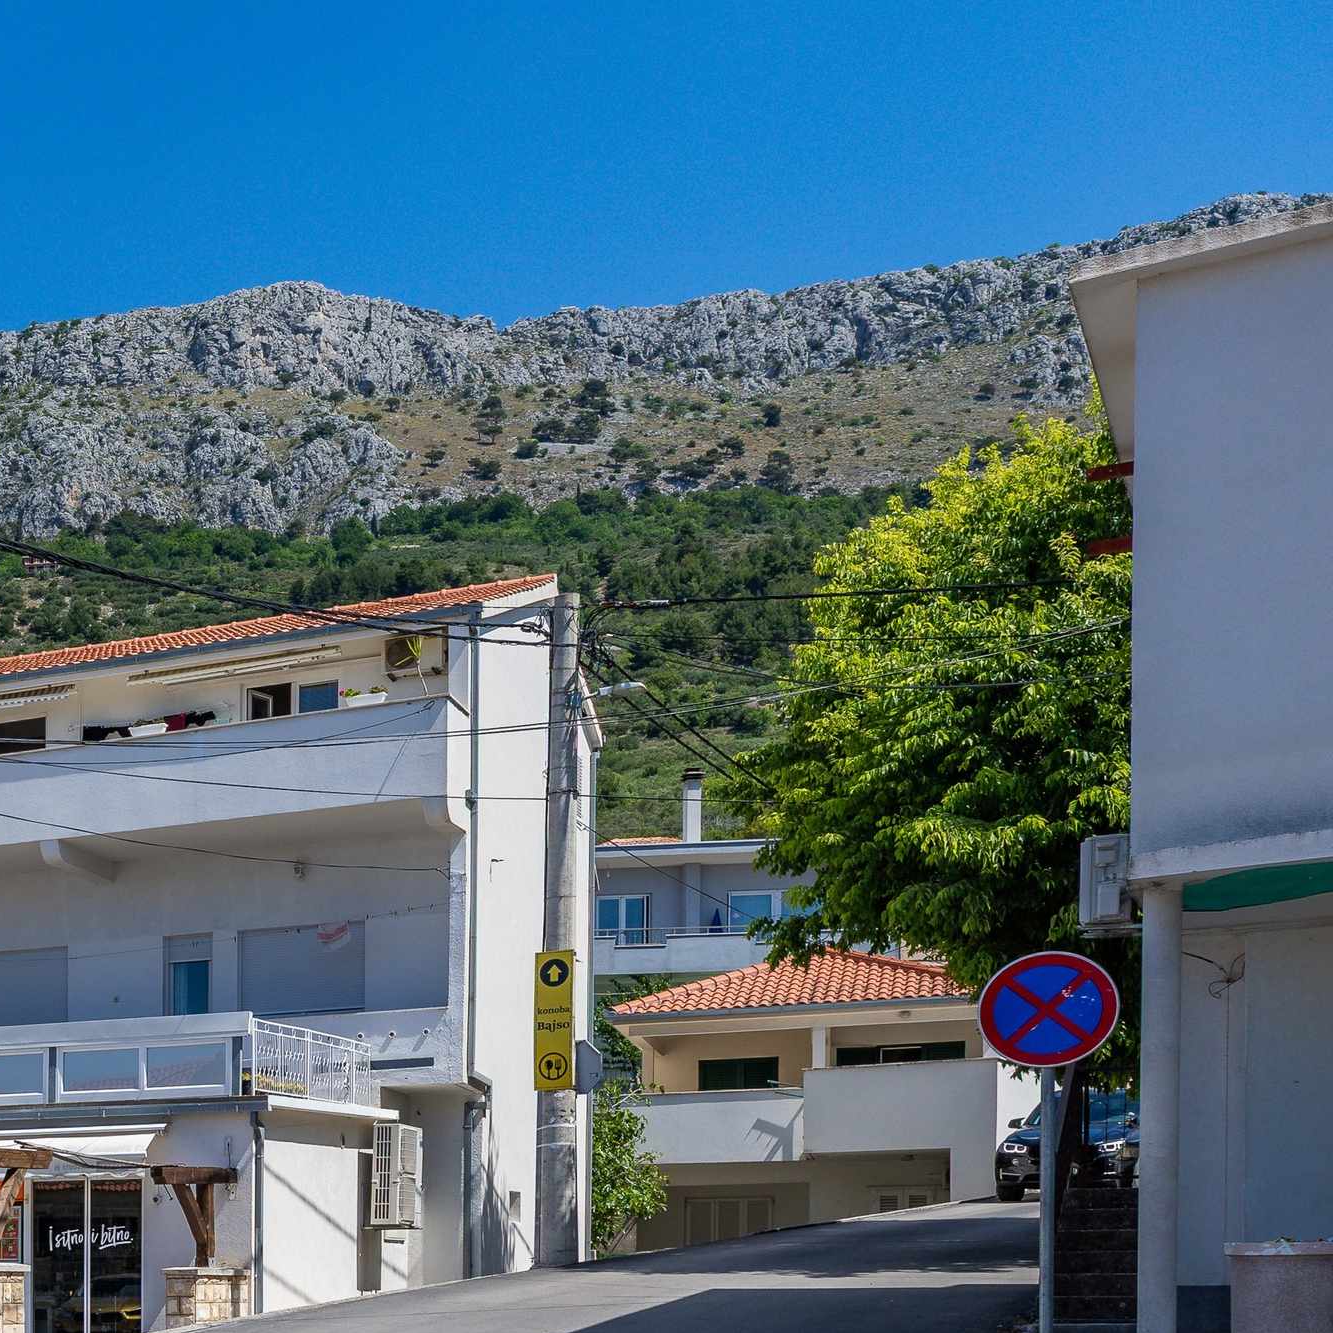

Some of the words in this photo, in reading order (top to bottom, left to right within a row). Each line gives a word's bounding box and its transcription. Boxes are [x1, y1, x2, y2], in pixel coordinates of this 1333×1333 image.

[537, 1005, 570, 1015] konoba
[537, 1020, 570, 1032] Bajso
[55, 1229, 83, 1250] sitno
[91, 1228, 99, 1244] i
